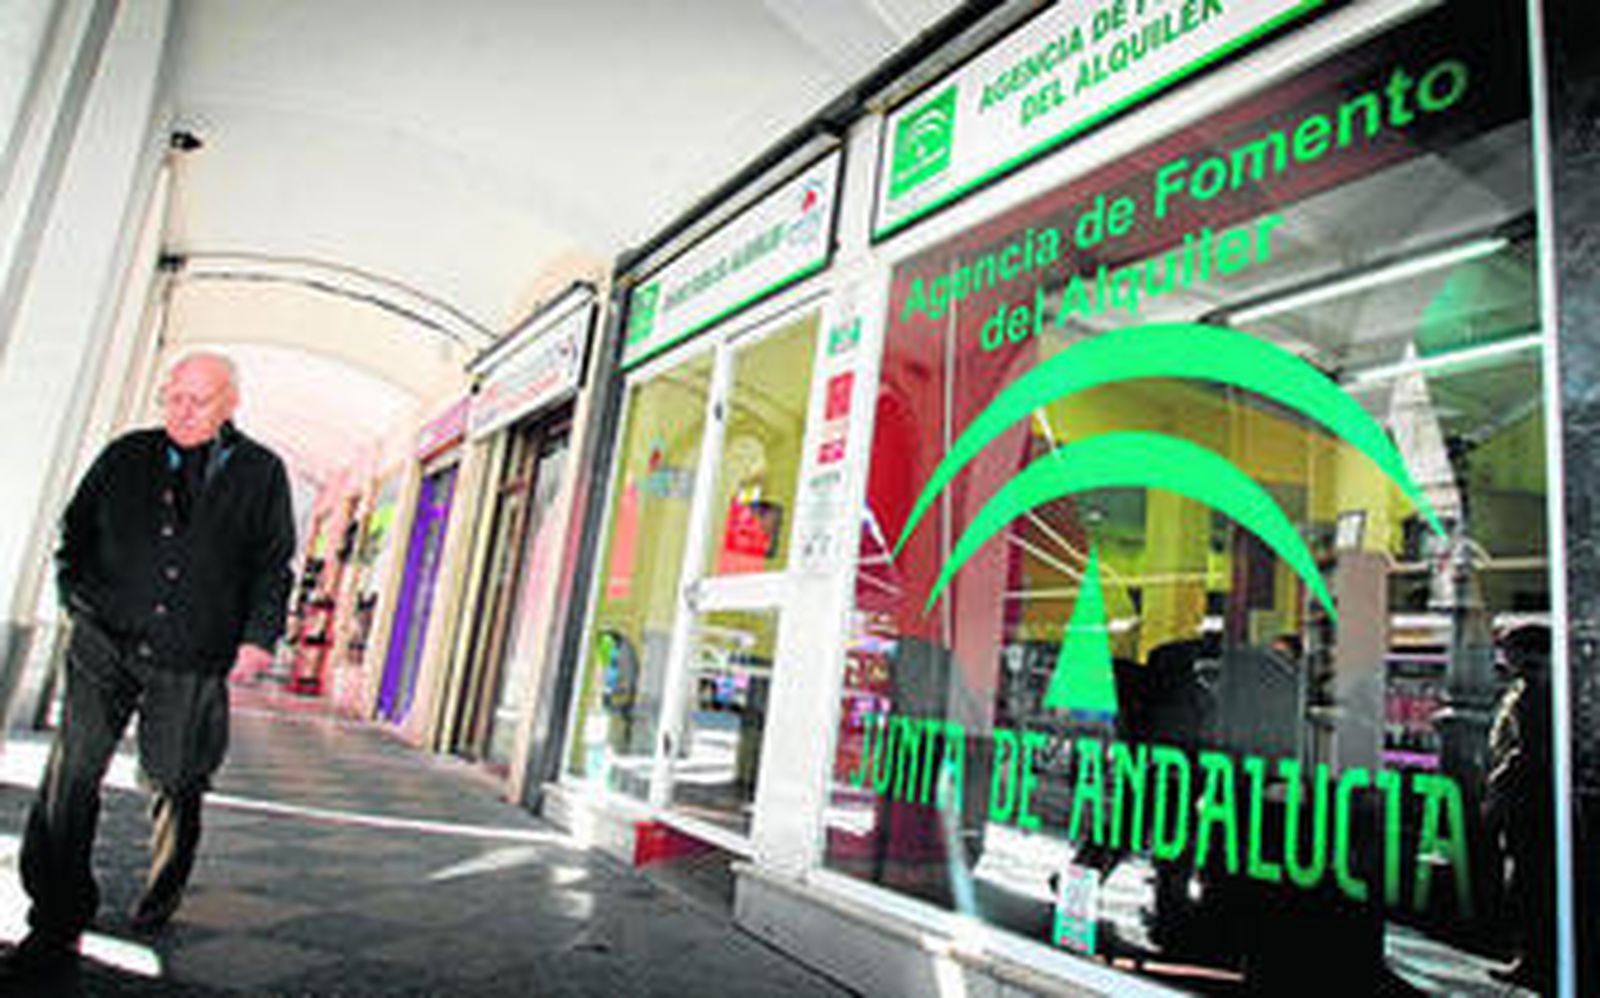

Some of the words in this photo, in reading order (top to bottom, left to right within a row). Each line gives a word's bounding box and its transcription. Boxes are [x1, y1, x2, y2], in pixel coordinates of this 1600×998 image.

[978, 26, 1085, 114] AGENCIA
[1091, 0, 1127, 42] DE
[1020, 79, 1067, 128] DEL
[1074, 0, 1224, 96] ALQUILER
[901, 227, 1062, 323] Agencia
[1074, 195, 1137, 250] de
[1154, 59, 1469, 219] Fomento
[979, 286, 1045, 352] del
[1055, 213, 1285, 328] Alquiler
[849, 712, 966, 812] JUNTA
[988, 727, 1045, 830] DE
